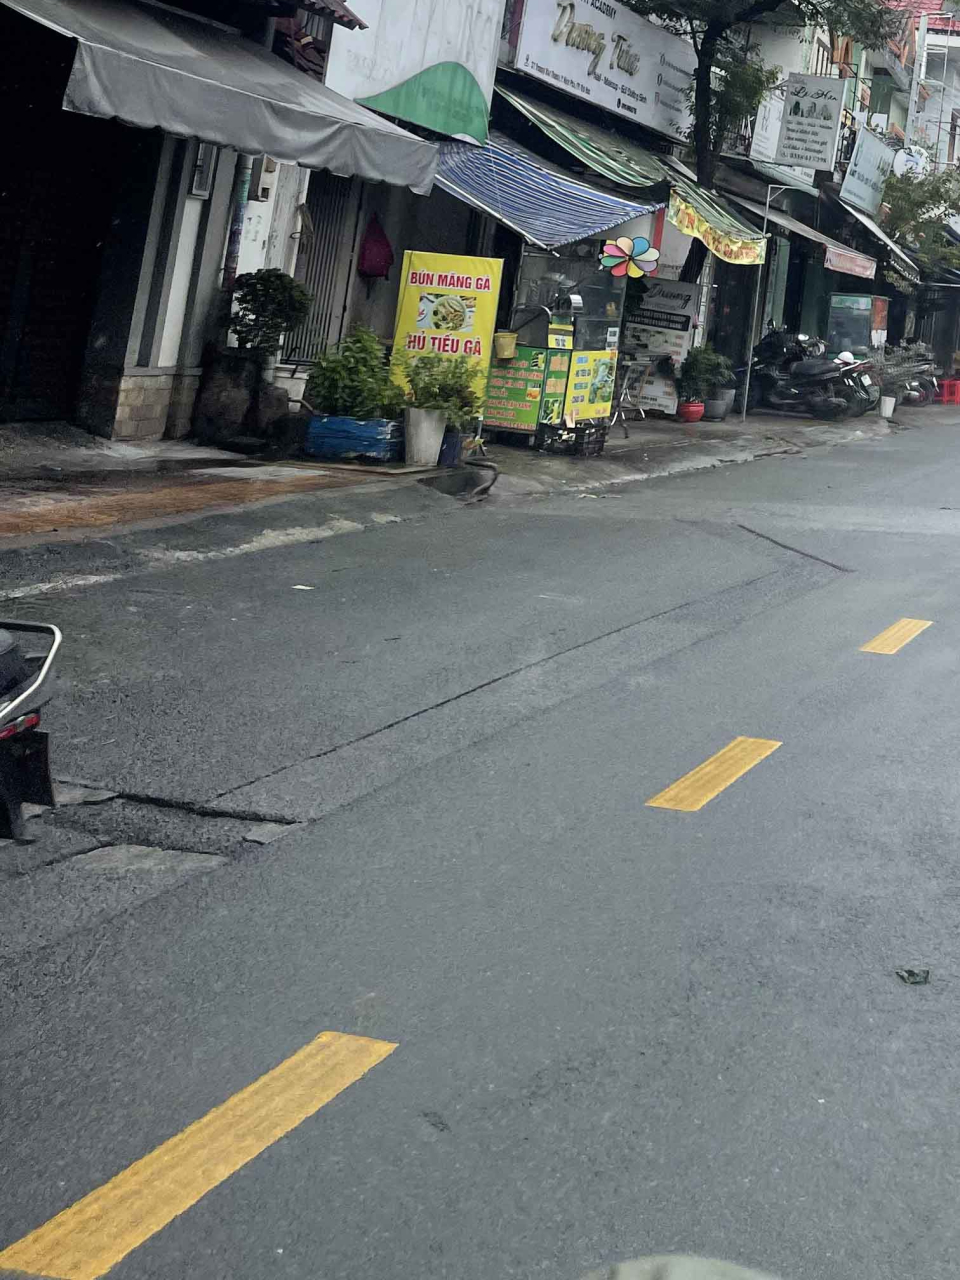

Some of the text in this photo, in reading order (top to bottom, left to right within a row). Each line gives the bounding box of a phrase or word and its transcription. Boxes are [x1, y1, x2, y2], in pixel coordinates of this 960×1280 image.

[410, 269, 491, 291] BÚN MĂNG GÀ
[407, 331, 482, 356] HỦ TIẾU GÀ
